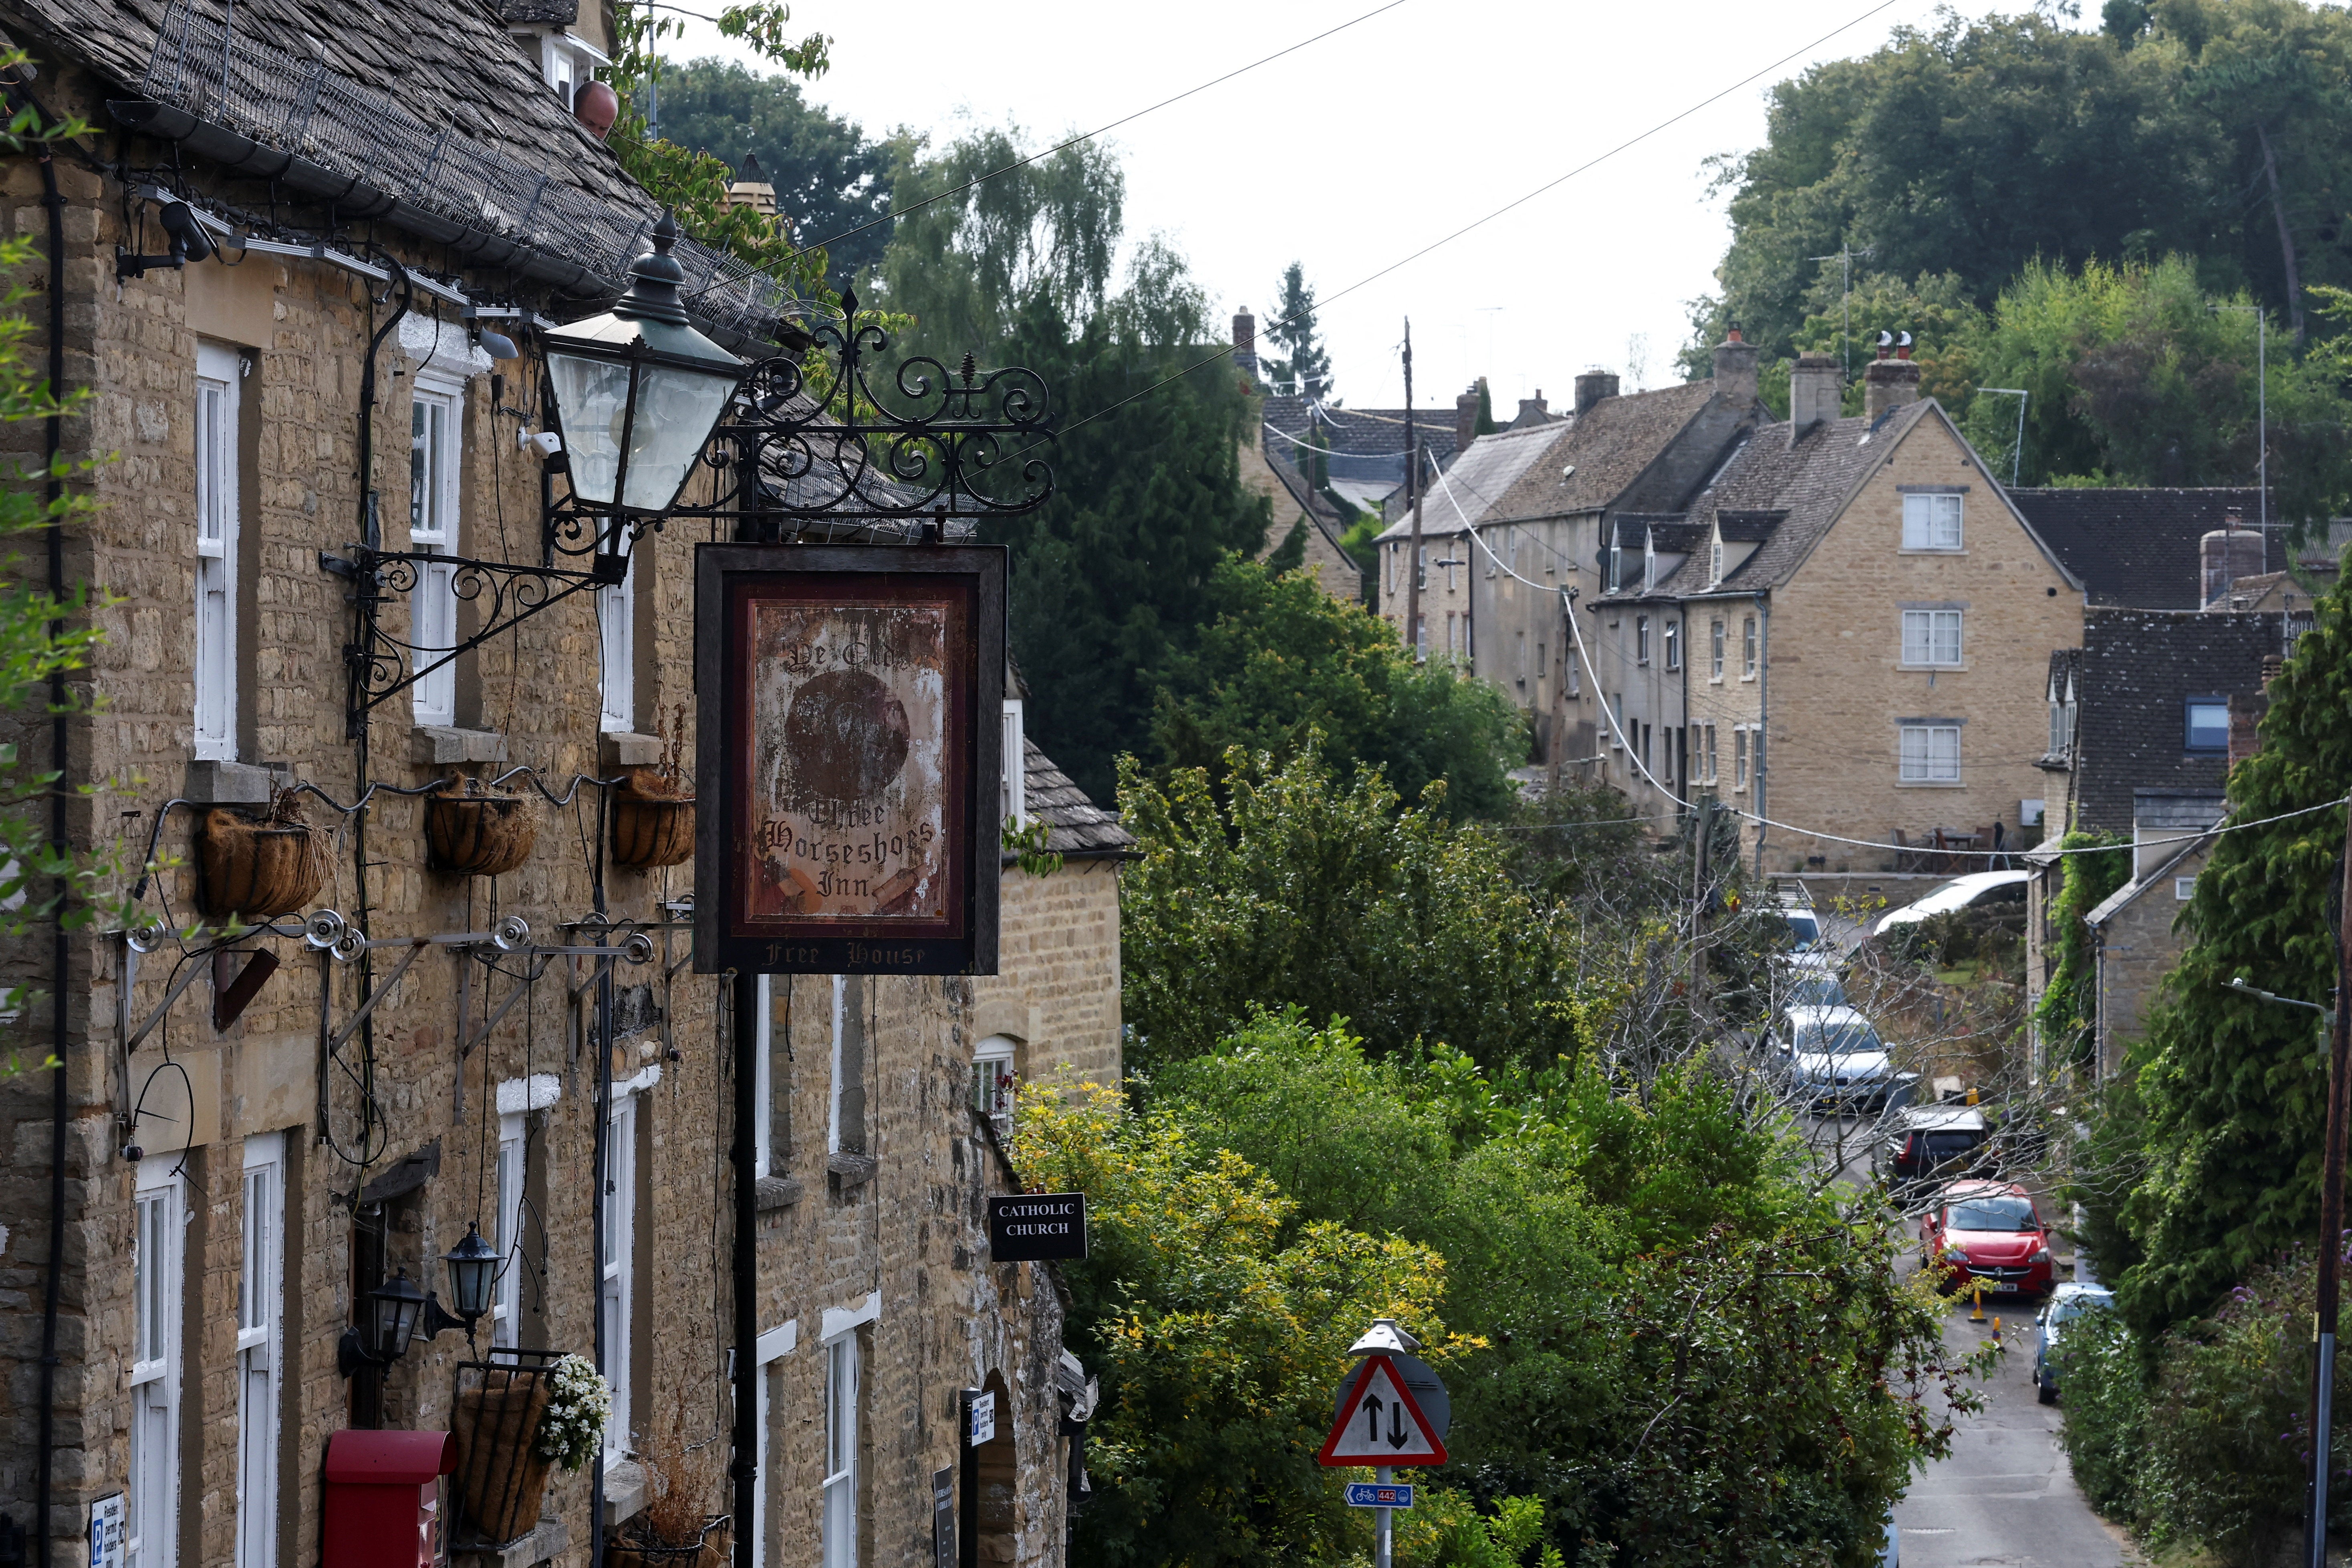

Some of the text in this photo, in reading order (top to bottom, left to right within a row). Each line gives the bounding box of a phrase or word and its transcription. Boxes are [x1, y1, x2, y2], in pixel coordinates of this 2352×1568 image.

[788, 642, 826, 672] Ye
[808, 800, 885, 831] Three
[764, 820, 934, 865] Horseshoes
[816, 871, 869, 897] Inn
[762, 942, 925, 967] Free House
[999, 1203, 1074, 1217] CATHOLIC
[1006, 1223, 1069, 1236] CHURCH
[979, 1398, 989, 1408] Resident
[975, 1412, 978, 1433] P
[980, 1420, 988, 1429] holders
[105, 1520, 117, 1538] permit
[95, 1524, 101, 1560] P
[104, 1538, 117, 1554] holders
